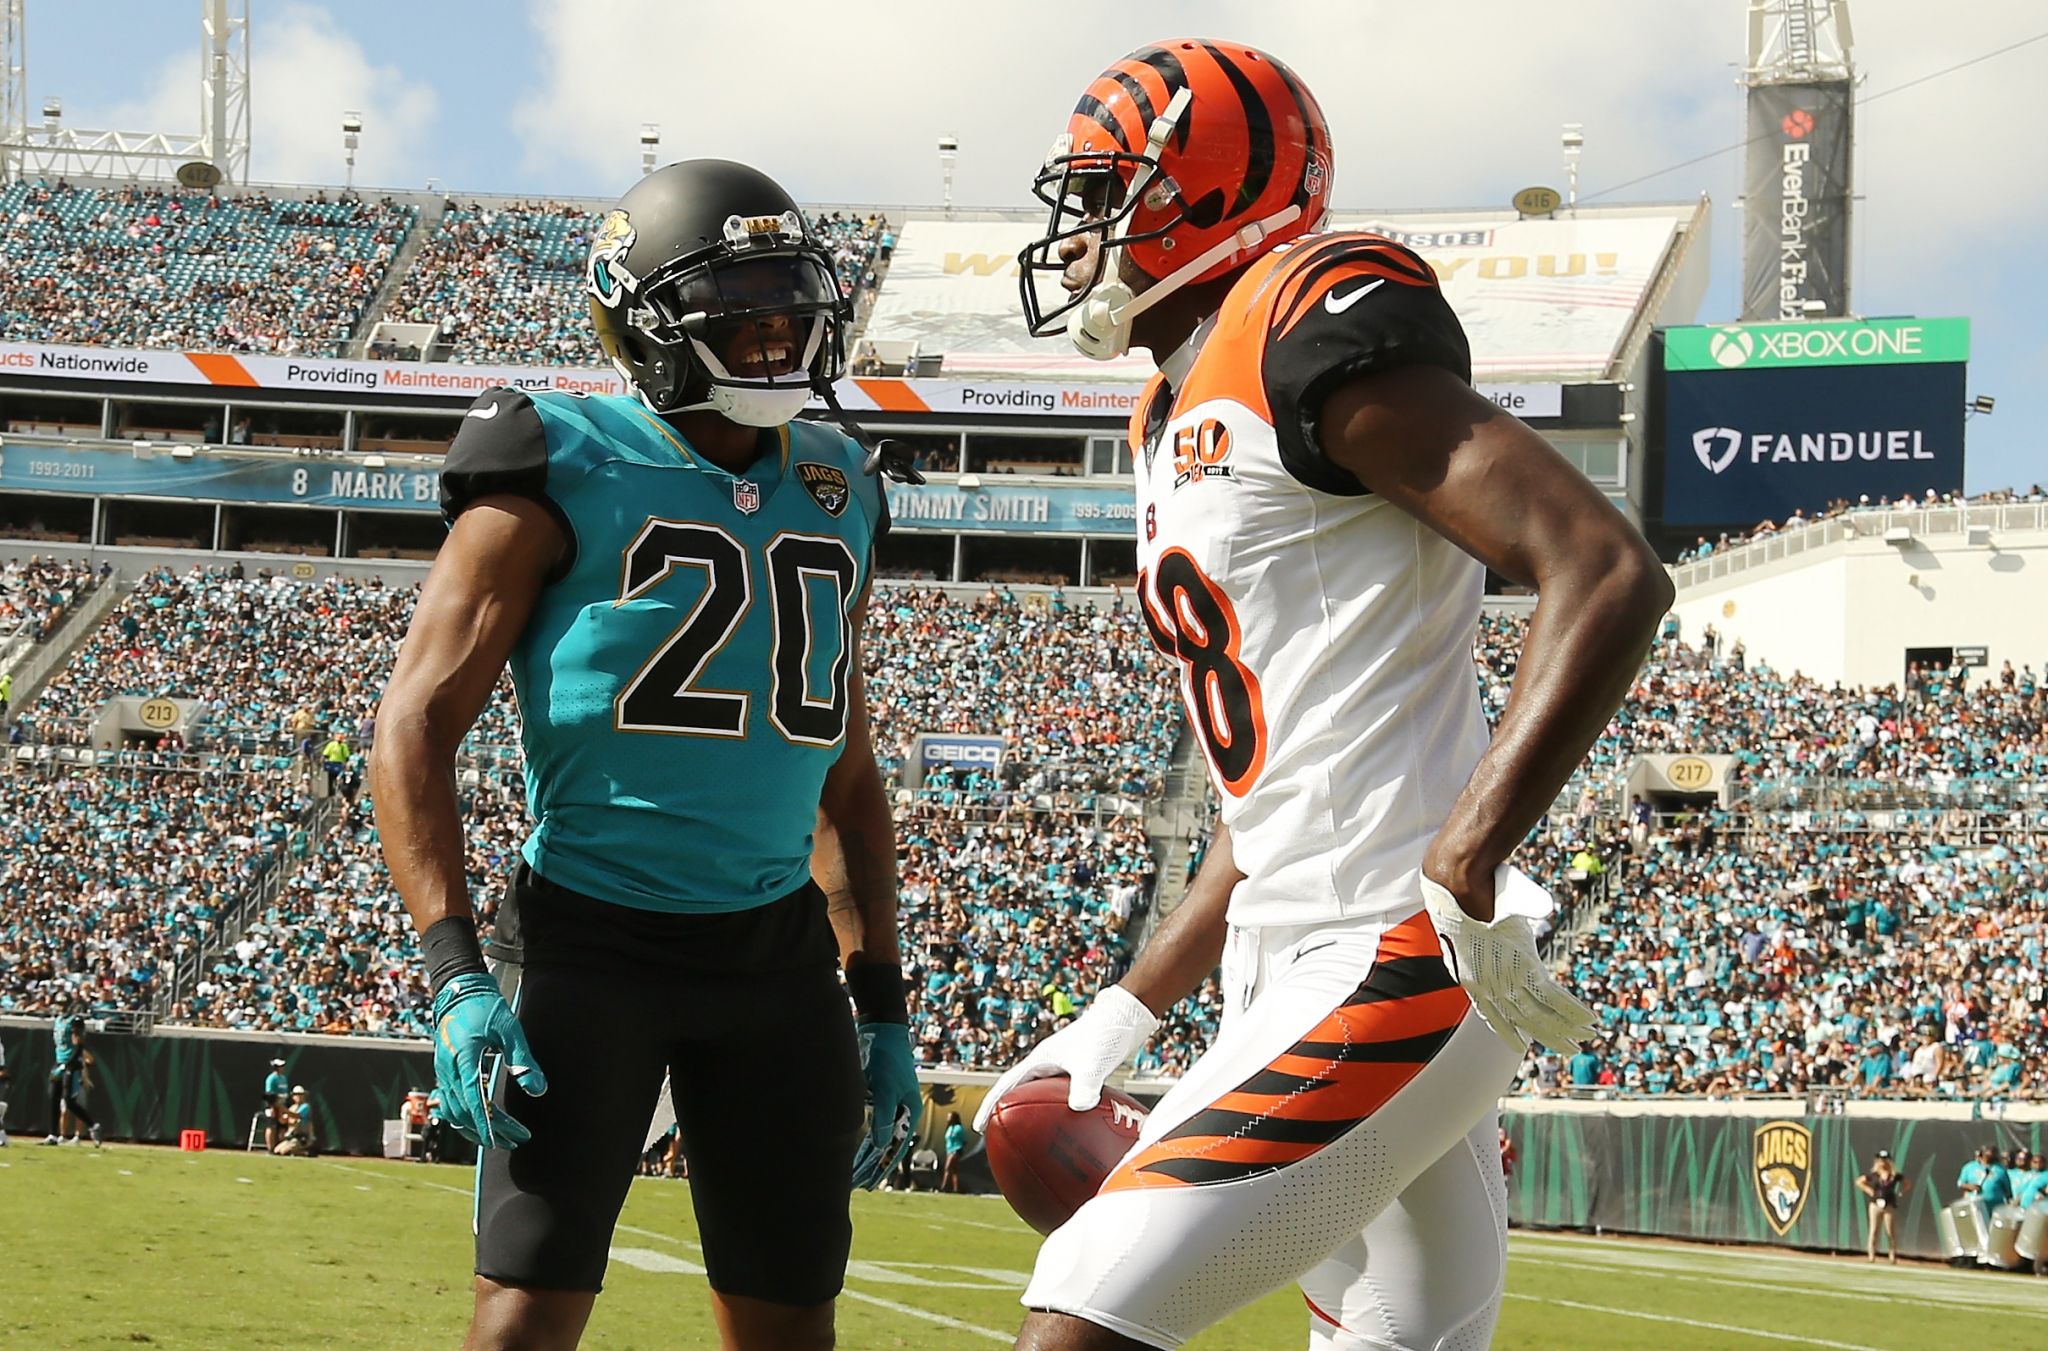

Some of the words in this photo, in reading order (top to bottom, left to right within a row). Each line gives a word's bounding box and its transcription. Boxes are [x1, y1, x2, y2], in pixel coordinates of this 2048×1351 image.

[1523, 192, 1551, 208] 416
[1780, 142, 1811, 260] EverBank
[1759, 329, 1848, 359] XBOX
[1852, 327, 1922, 356] ONE
[40, 353, 149, 374] Nationwide
[287, 365, 378, 388] Providing
[383, 369, 508, 389] Maintenance
[555, 376, 617, 394] Repair
[962, 388, 1056, 411] Providing
[1173, 418, 1231, 475] 50
[1751, 430, 1935, 463] FANDUEL
[29, 461, 95, 479] 1993-2011
[803, 465, 845, 486] JAGS
[292, 468, 308, 495] 8
[331, 470, 404, 500] MARK
[738, 493, 756, 508] NFL
[890, 491, 969, 520] JIMMY
[974, 494, 1048, 523] SMITH
[613, 515, 857, 747] 20
[147, 705, 172, 720] 213
[925, 744, 1000, 762] GEICO
[1676, 765, 1703, 780] 217
[186, 1132, 202, 1150] 10
[1757, 1129, 1808, 1170] JAGS
